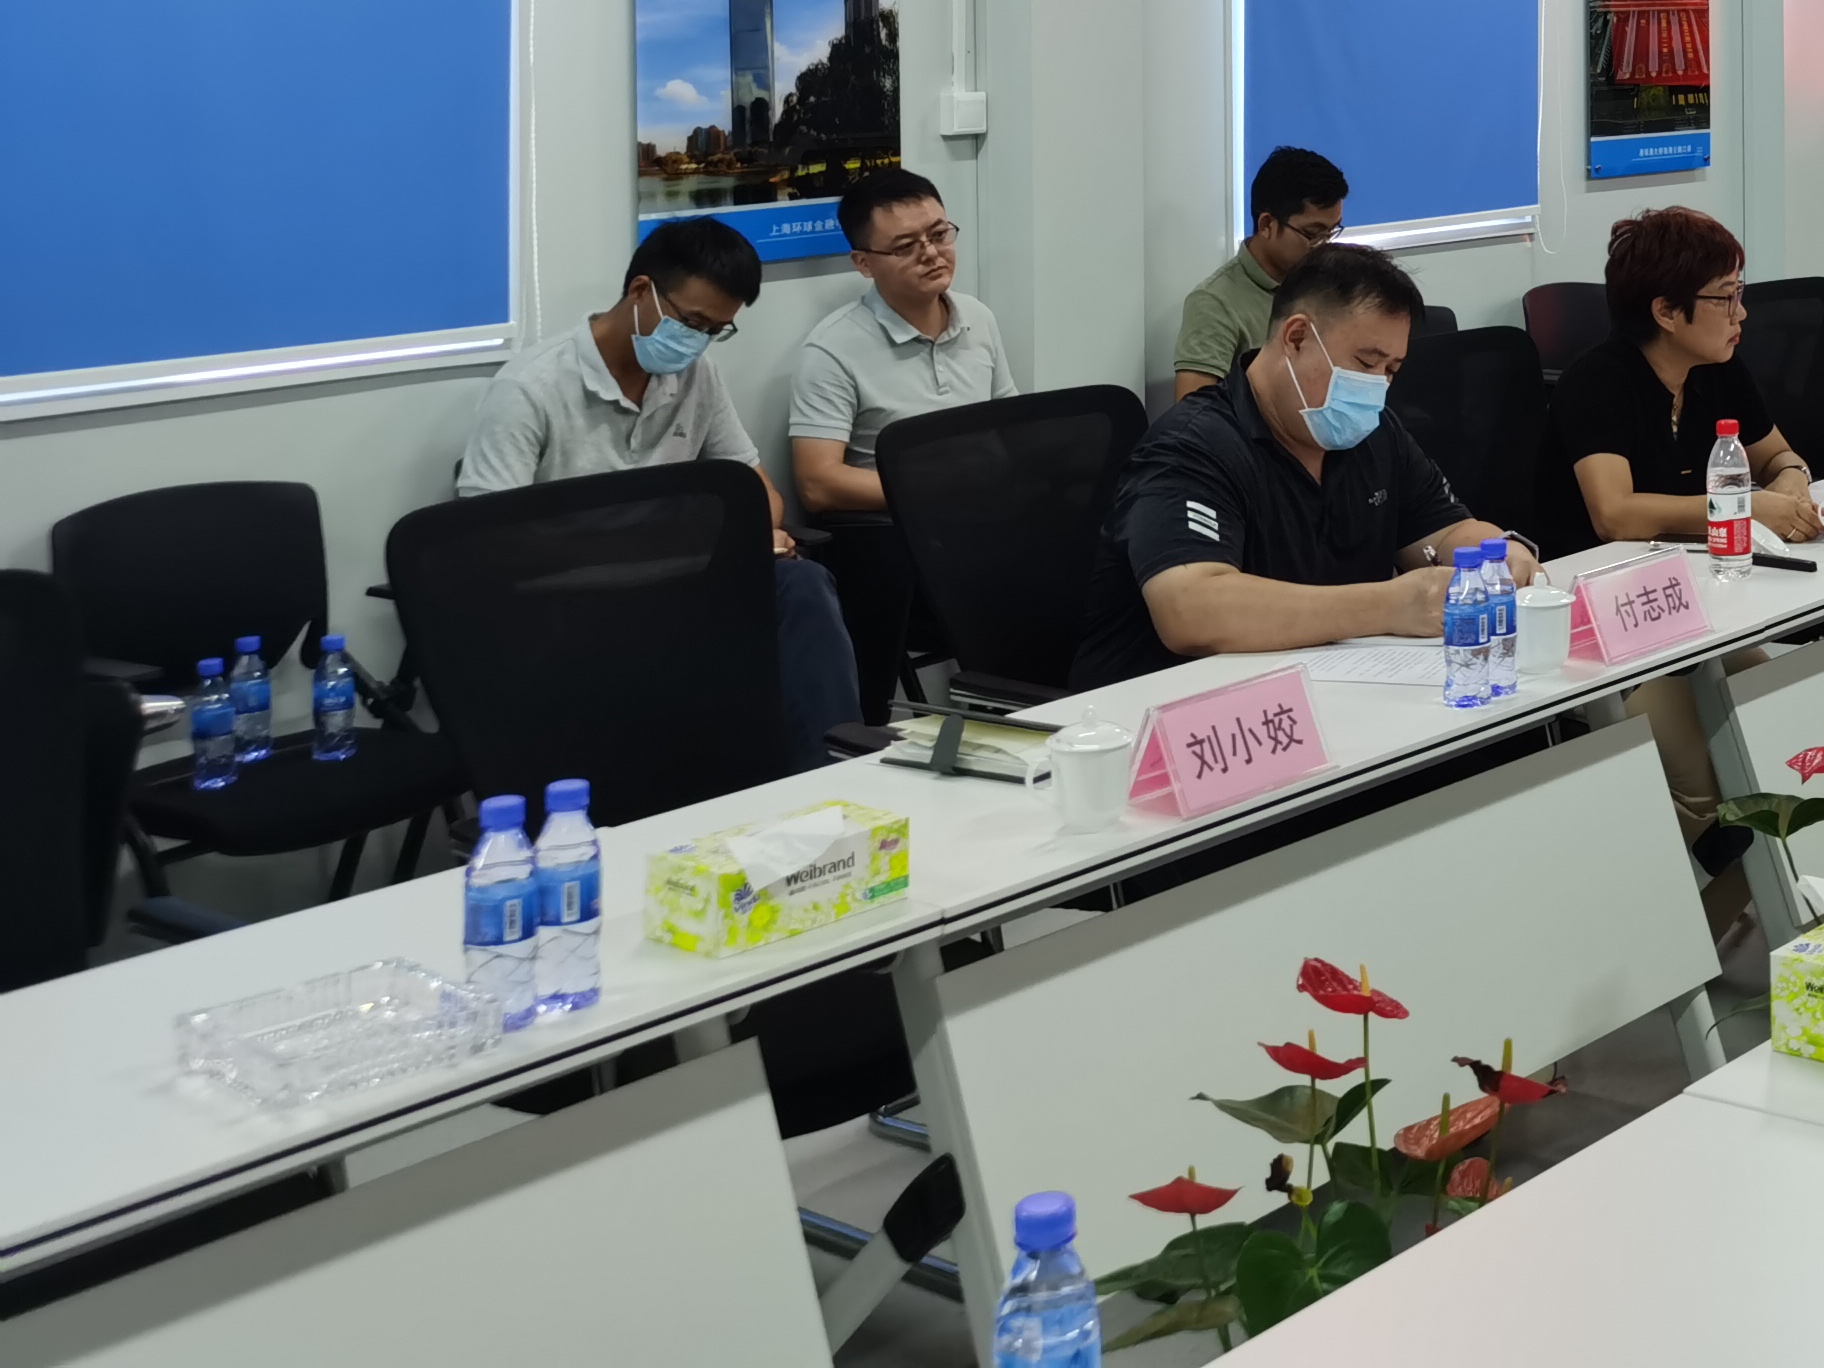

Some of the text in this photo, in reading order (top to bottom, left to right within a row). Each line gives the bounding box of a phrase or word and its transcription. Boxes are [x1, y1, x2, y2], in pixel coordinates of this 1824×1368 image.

[1615, 576, 1690, 632] 付志成
[1185, 703, 1304, 780] 刘小姣
